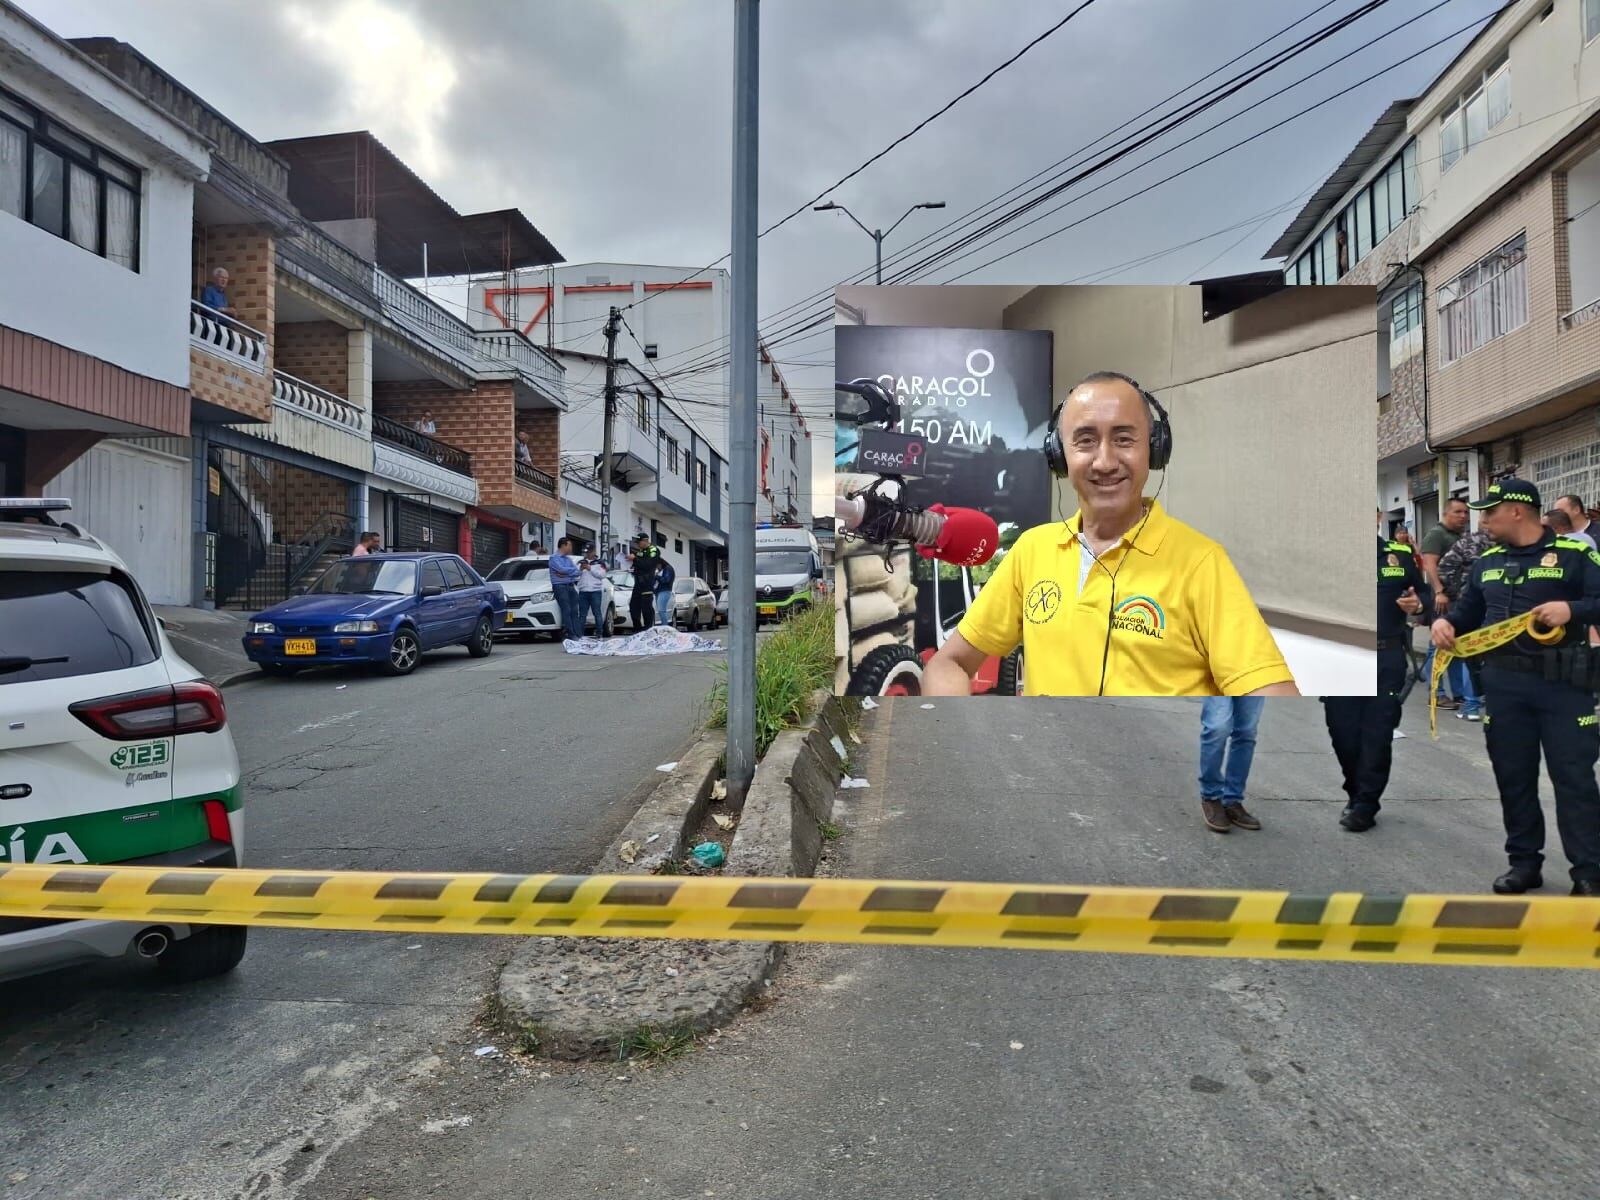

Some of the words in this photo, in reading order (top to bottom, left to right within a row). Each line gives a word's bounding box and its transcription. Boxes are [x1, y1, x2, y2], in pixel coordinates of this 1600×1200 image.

[877, 374, 992, 397] CARACOL
[898, 395, 967, 407] RADIO
[877, 419, 942, 444] 150
[947, 420, 993, 446] AM
[864, 450, 919, 465] CARACOL
[1111, 620, 1164, 640] NACIONAL
[129, 743, 166, 765] 123
